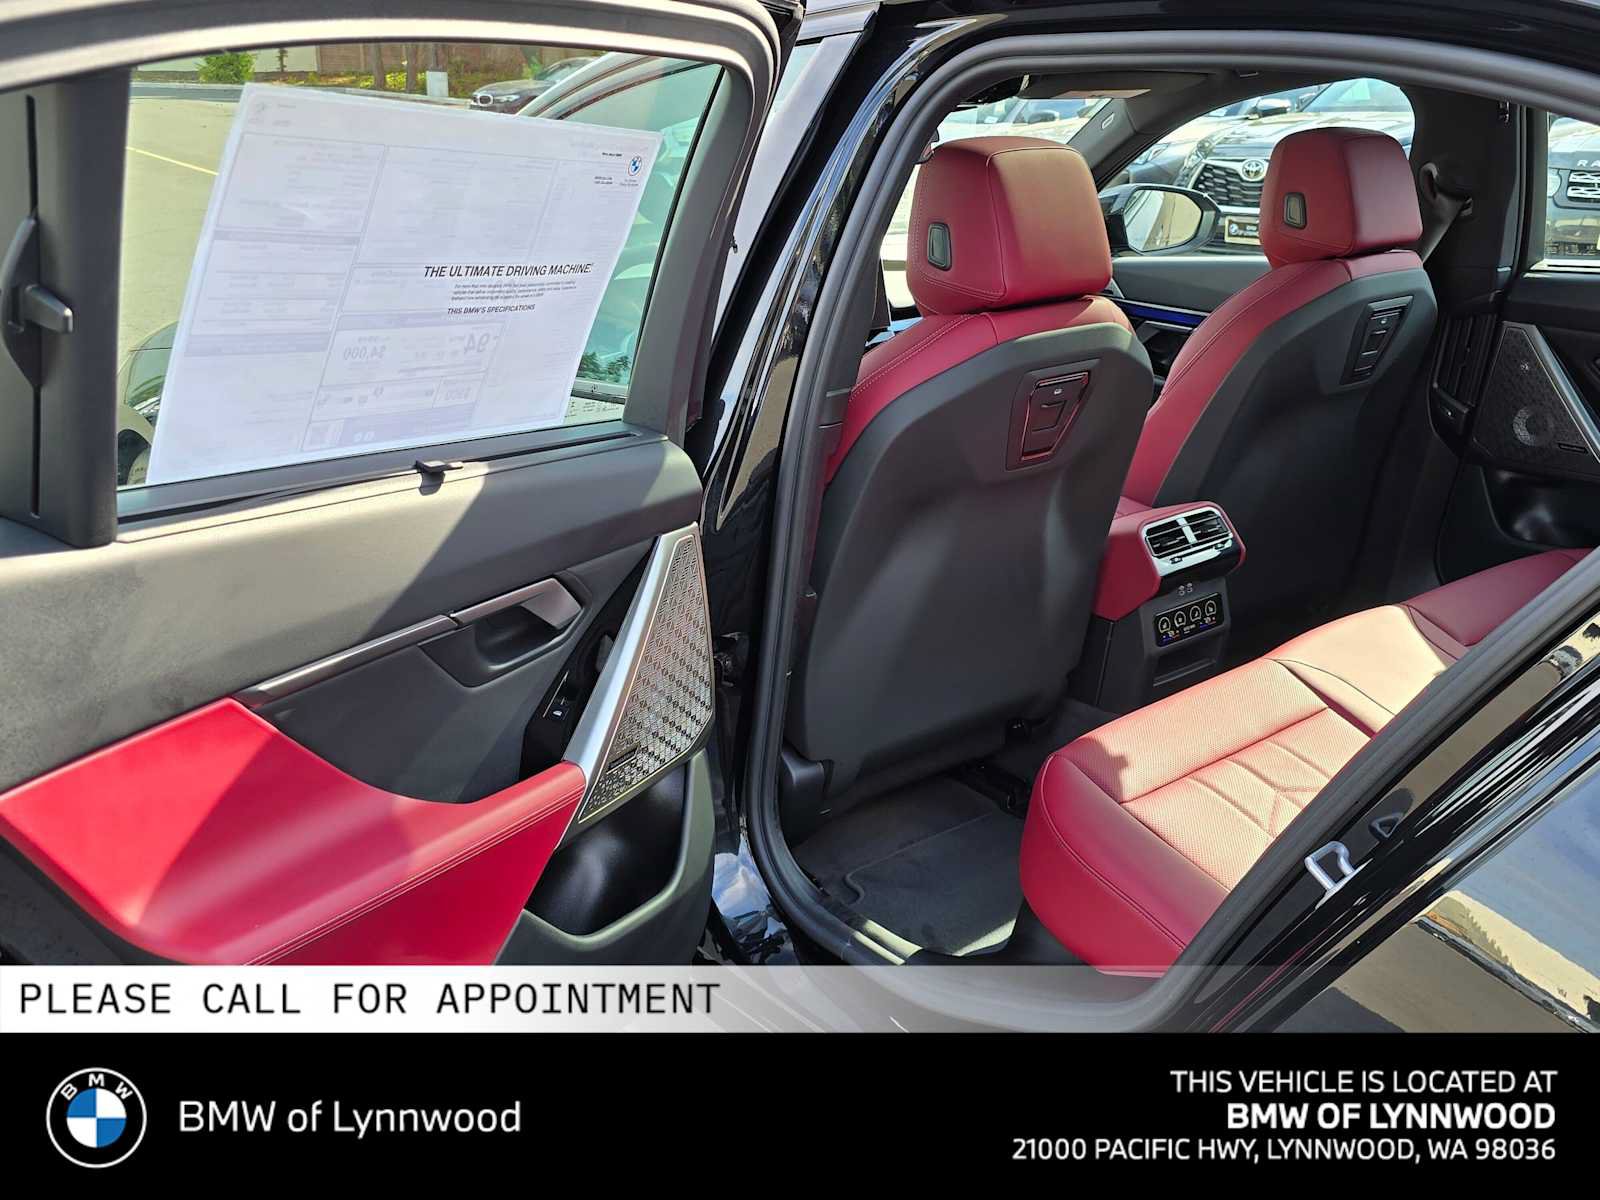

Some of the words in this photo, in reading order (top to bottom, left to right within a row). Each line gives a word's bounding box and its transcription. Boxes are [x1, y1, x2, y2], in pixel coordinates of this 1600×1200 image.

[424, 265, 448, 277] THE
[449, 265, 505, 277] ULTIMATE
[506, 264, 547, 277] DRIVING
[447, 307, 463, 315] THIS
[463, 306, 487, 315] BMW'S
[487, 303, 536, 313] SPECIFICATIONS
